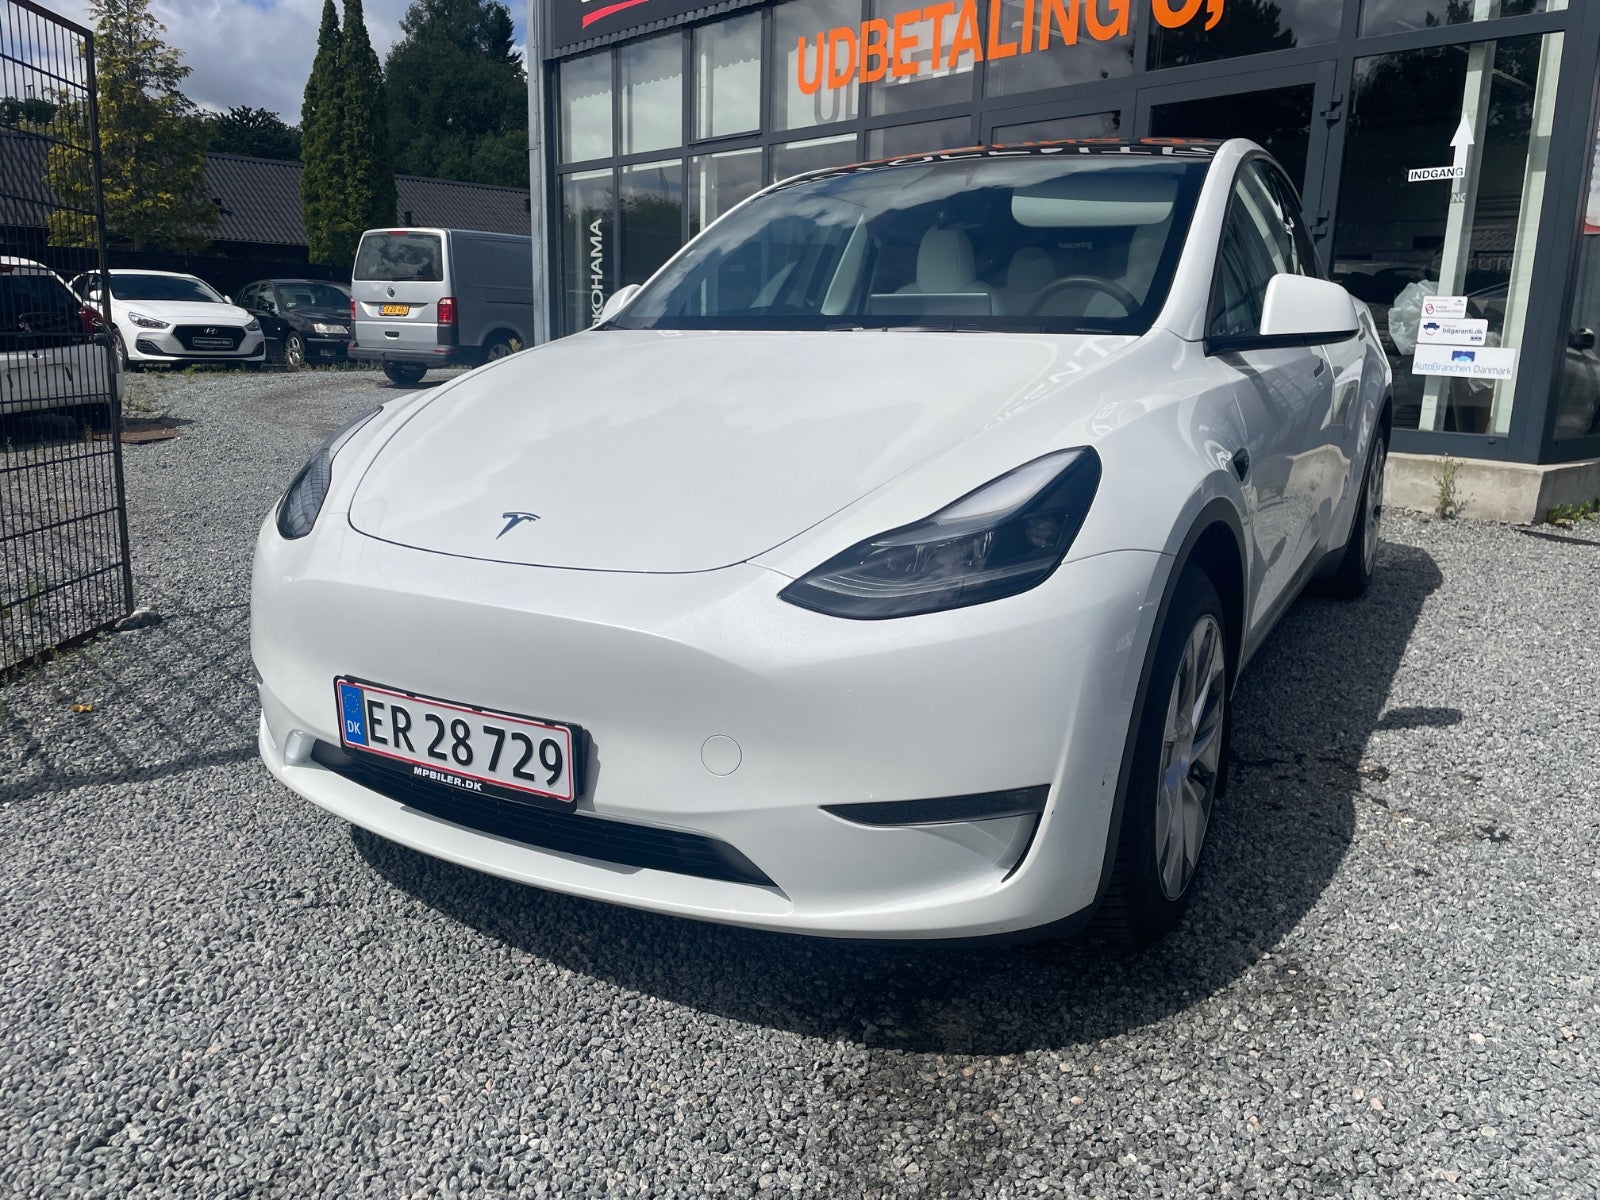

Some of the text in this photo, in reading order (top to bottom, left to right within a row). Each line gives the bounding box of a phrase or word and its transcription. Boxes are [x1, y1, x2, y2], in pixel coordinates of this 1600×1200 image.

[797, 0, 1130, 95] UDBETALING
[1410, 167, 1464, 180] INDGANG
[1442, 327, 1483, 335] bilgaranti.dk
[1413, 362, 1511, 375] AutoBranchen Danmark
[346, 720, 362, 735] DK
[366, 699, 563, 786] ER 28 729
[413, 766, 483, 791] MPBILER.DK
